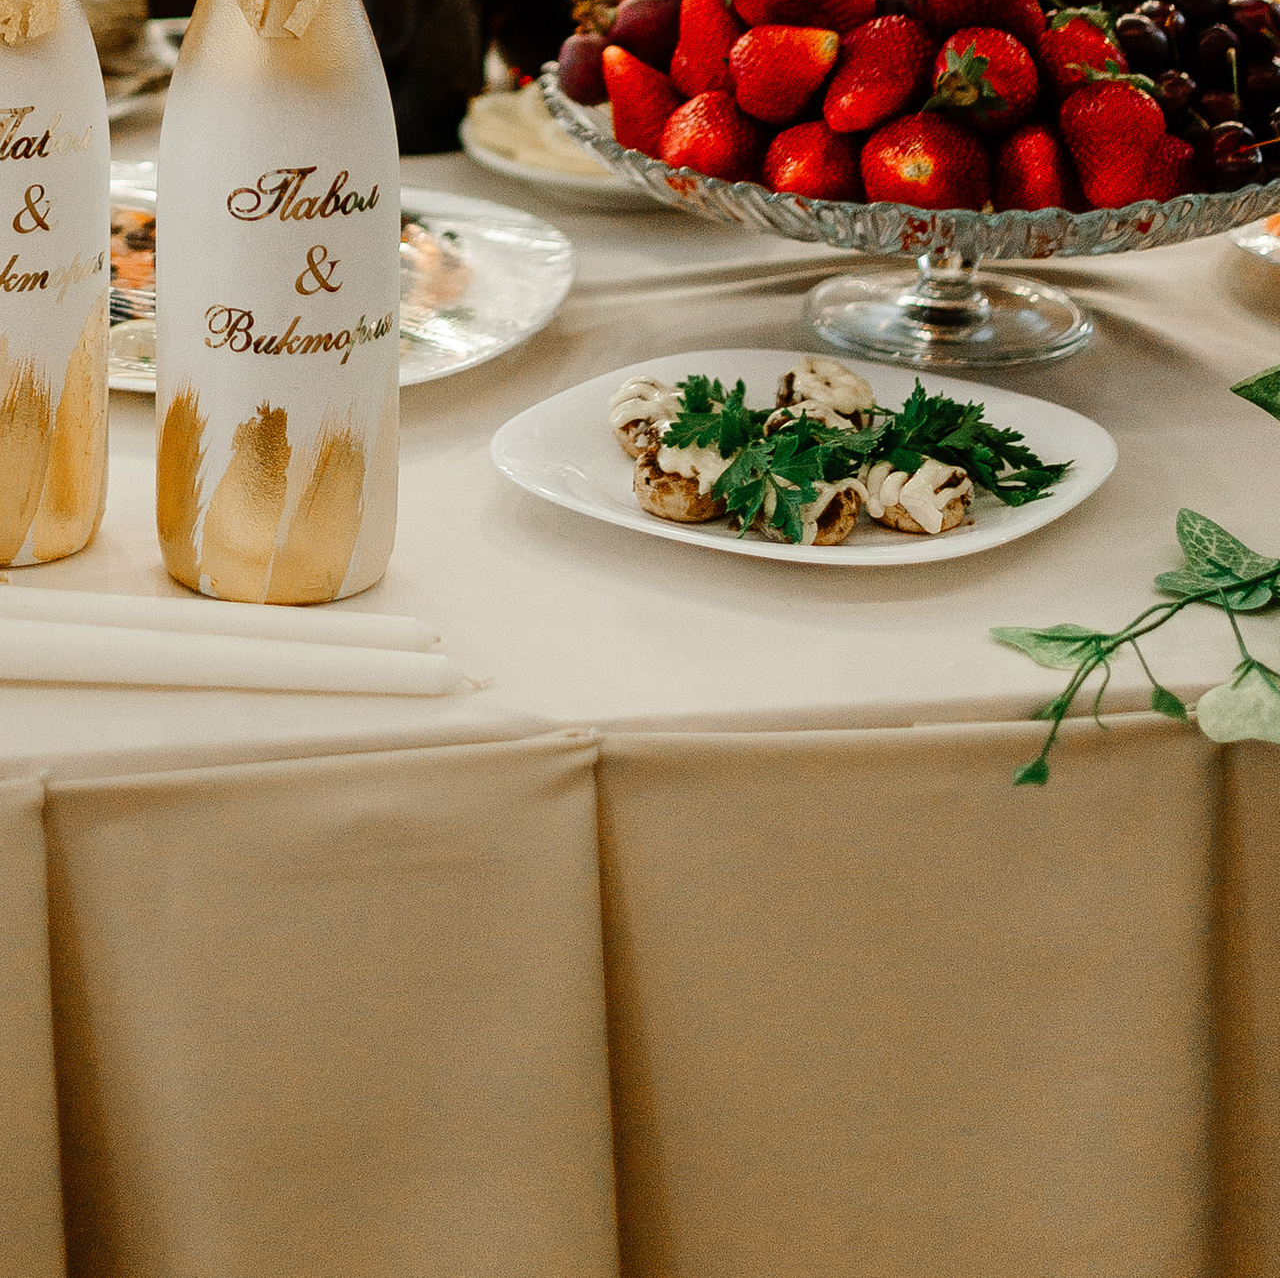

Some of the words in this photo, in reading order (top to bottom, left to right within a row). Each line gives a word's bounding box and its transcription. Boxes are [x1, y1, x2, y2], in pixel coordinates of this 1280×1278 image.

[12, 183, 59, 234] &
[226, 165, 381, 222] Павол
[294, 244, 344, 296] &
[203, 303, 394, 366] Виктория
